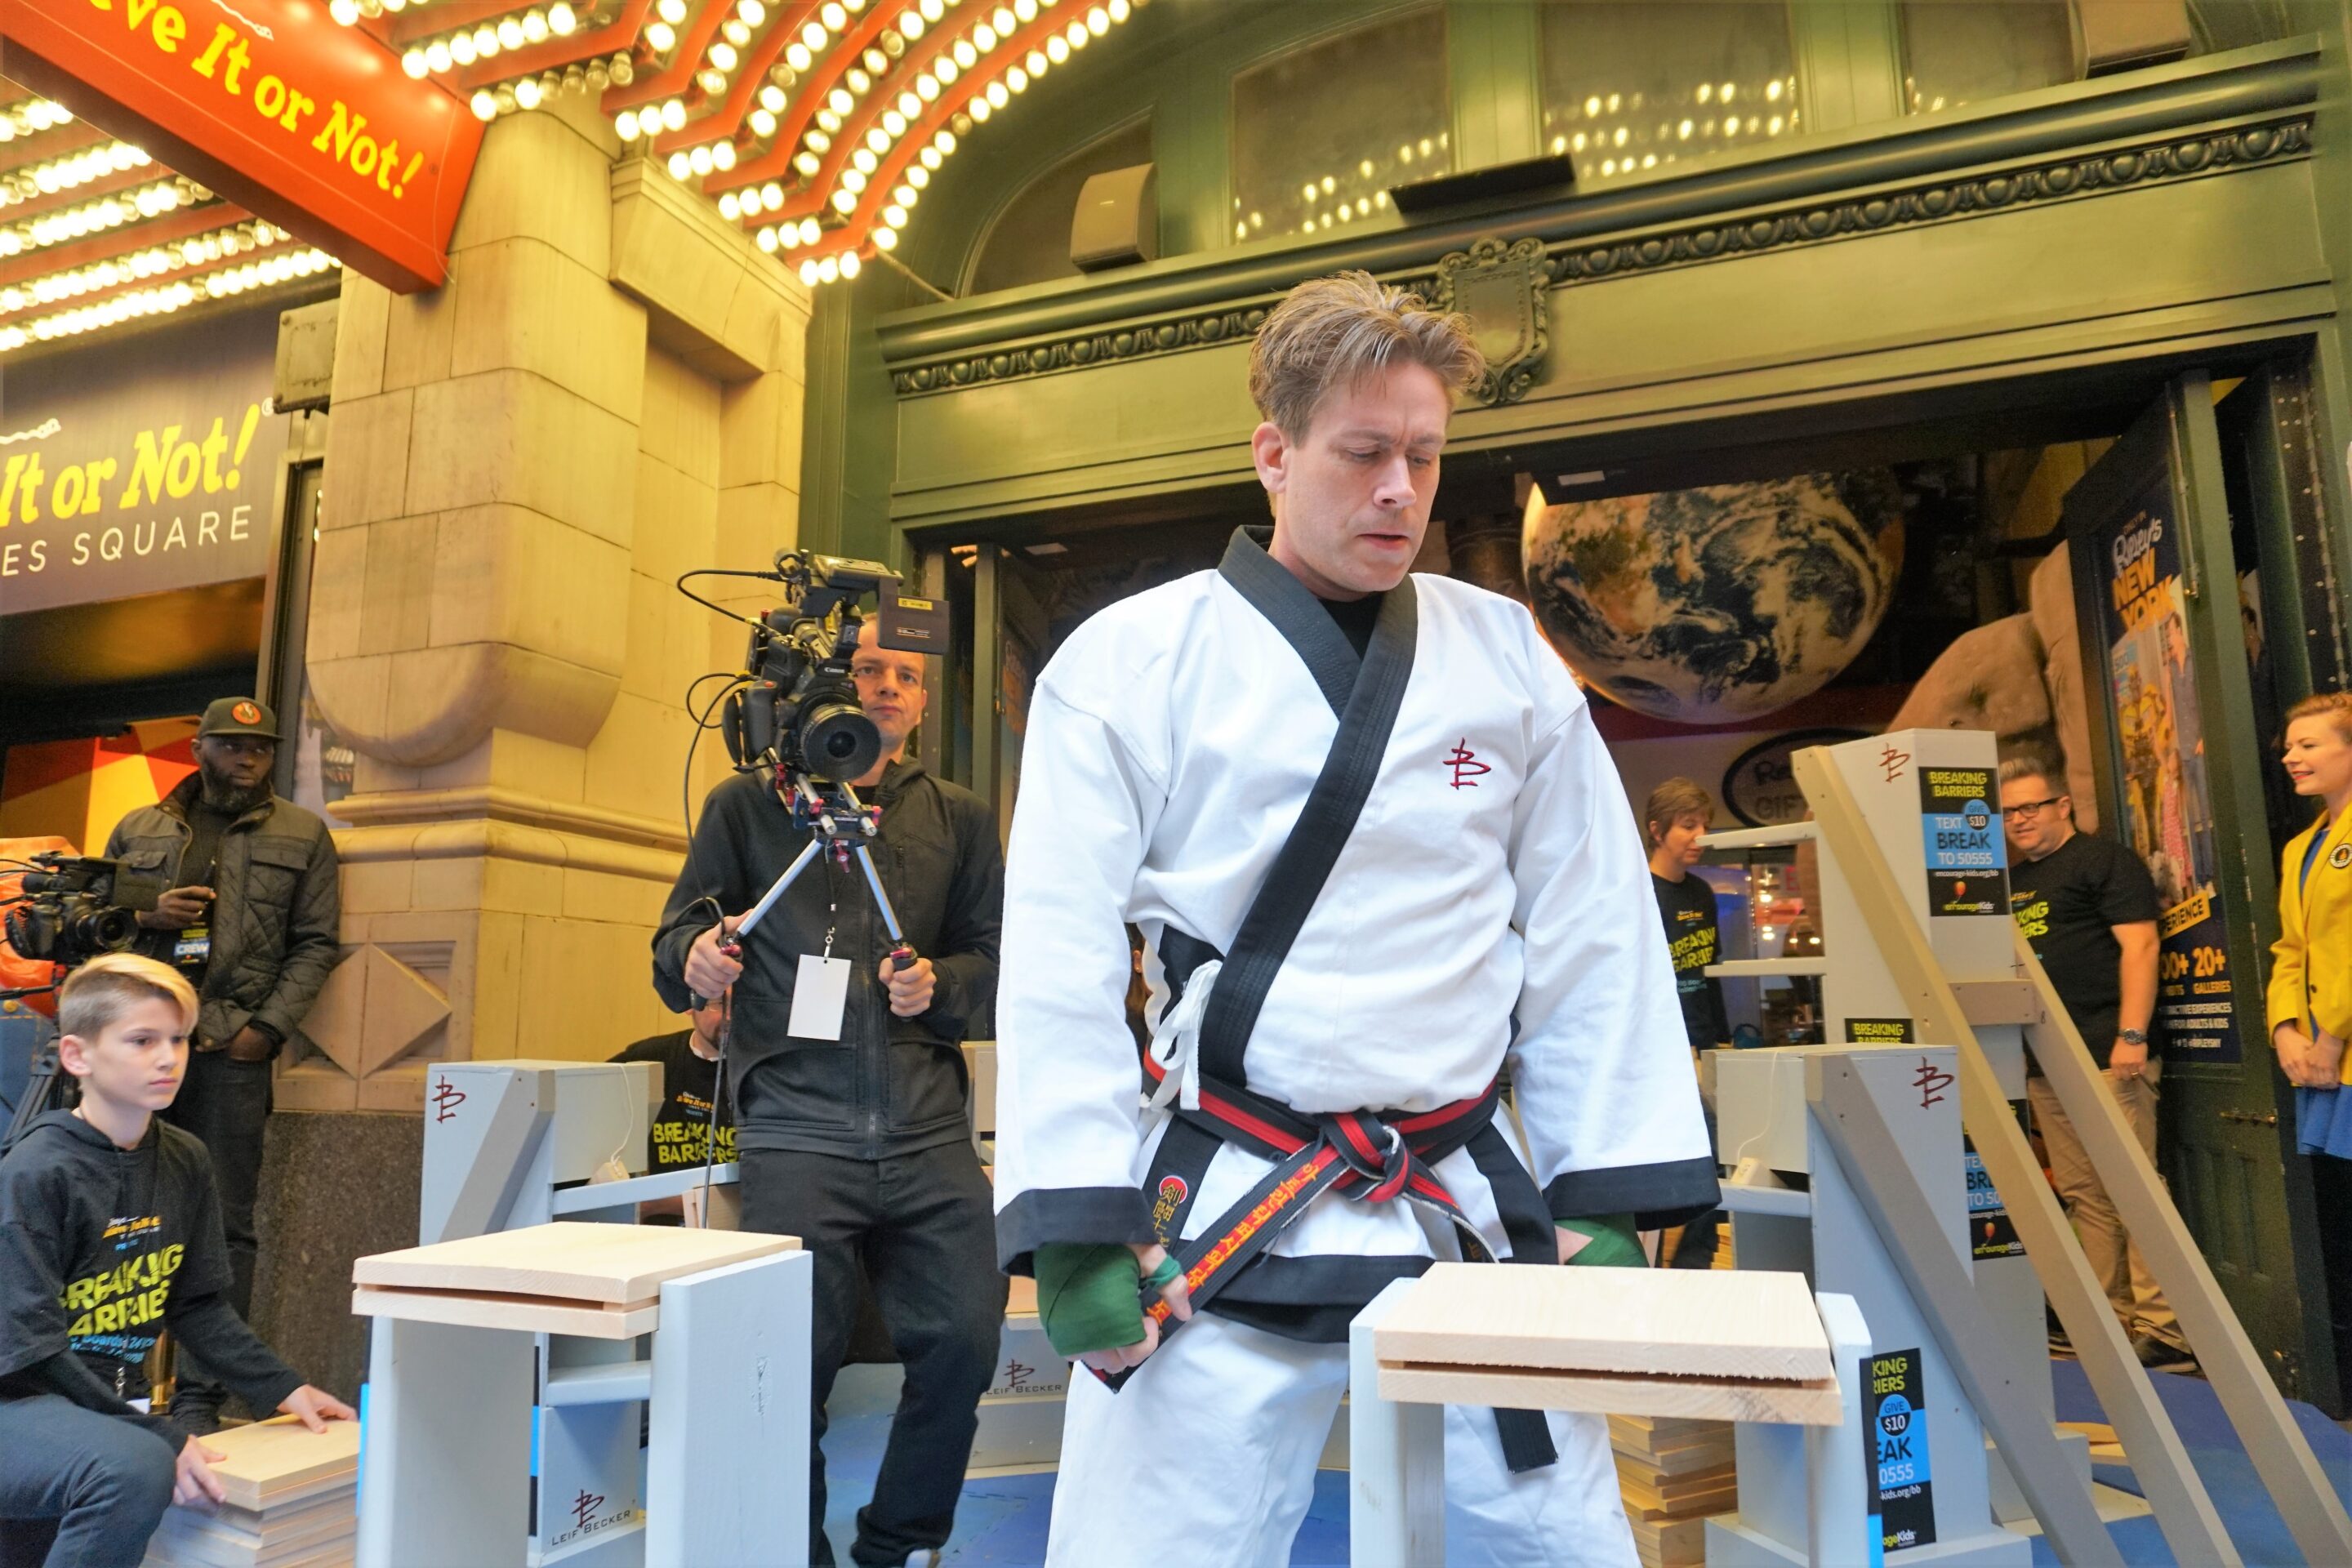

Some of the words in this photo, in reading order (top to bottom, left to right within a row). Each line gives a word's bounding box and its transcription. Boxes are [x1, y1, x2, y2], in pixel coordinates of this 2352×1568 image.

[190, 22, 252, 95] It
[254, 75, 315, 133] or
[311, 99, 425, 199] Not!
[51, 457, 117, 519] or
[119, 403, 260, 509] Not!
[72, 505, 252, 565] SQUARE
[2112, 547, 2156, 612] NEW
[1929, 770, 1988, 786] BREAKING
[1933, 785, 1986, 799] BARRIERS
[1969, 804, 1985, 814] GIVE
[1936, 817, 1962, 830] TEXT
[1969, 816, 1986, 827] $10
[1937, 832, 1992, 850] BREAK
[1939, 852, 1956, 866] TO
[1958, 852, 1993, 866] 50555
[2192, 946, 2226, 978] 20+
[2193, 980, 2232, 995] GALLERIES
[1853, 1022, 1904, 1036] BREAKING
[1967, 1192, 1984, 1206] TO
[986, 1387, 1009, 1395] LEIF
[1015, 1384, 1062, 1393] BECKER
[1884, 1402, 1904, 1414] GIVE
[1885, 1415, 1905, 1431] $10
[551, 1529, 578, 1546] LEIF
[583, 1509, 630, 1535] BECKER
